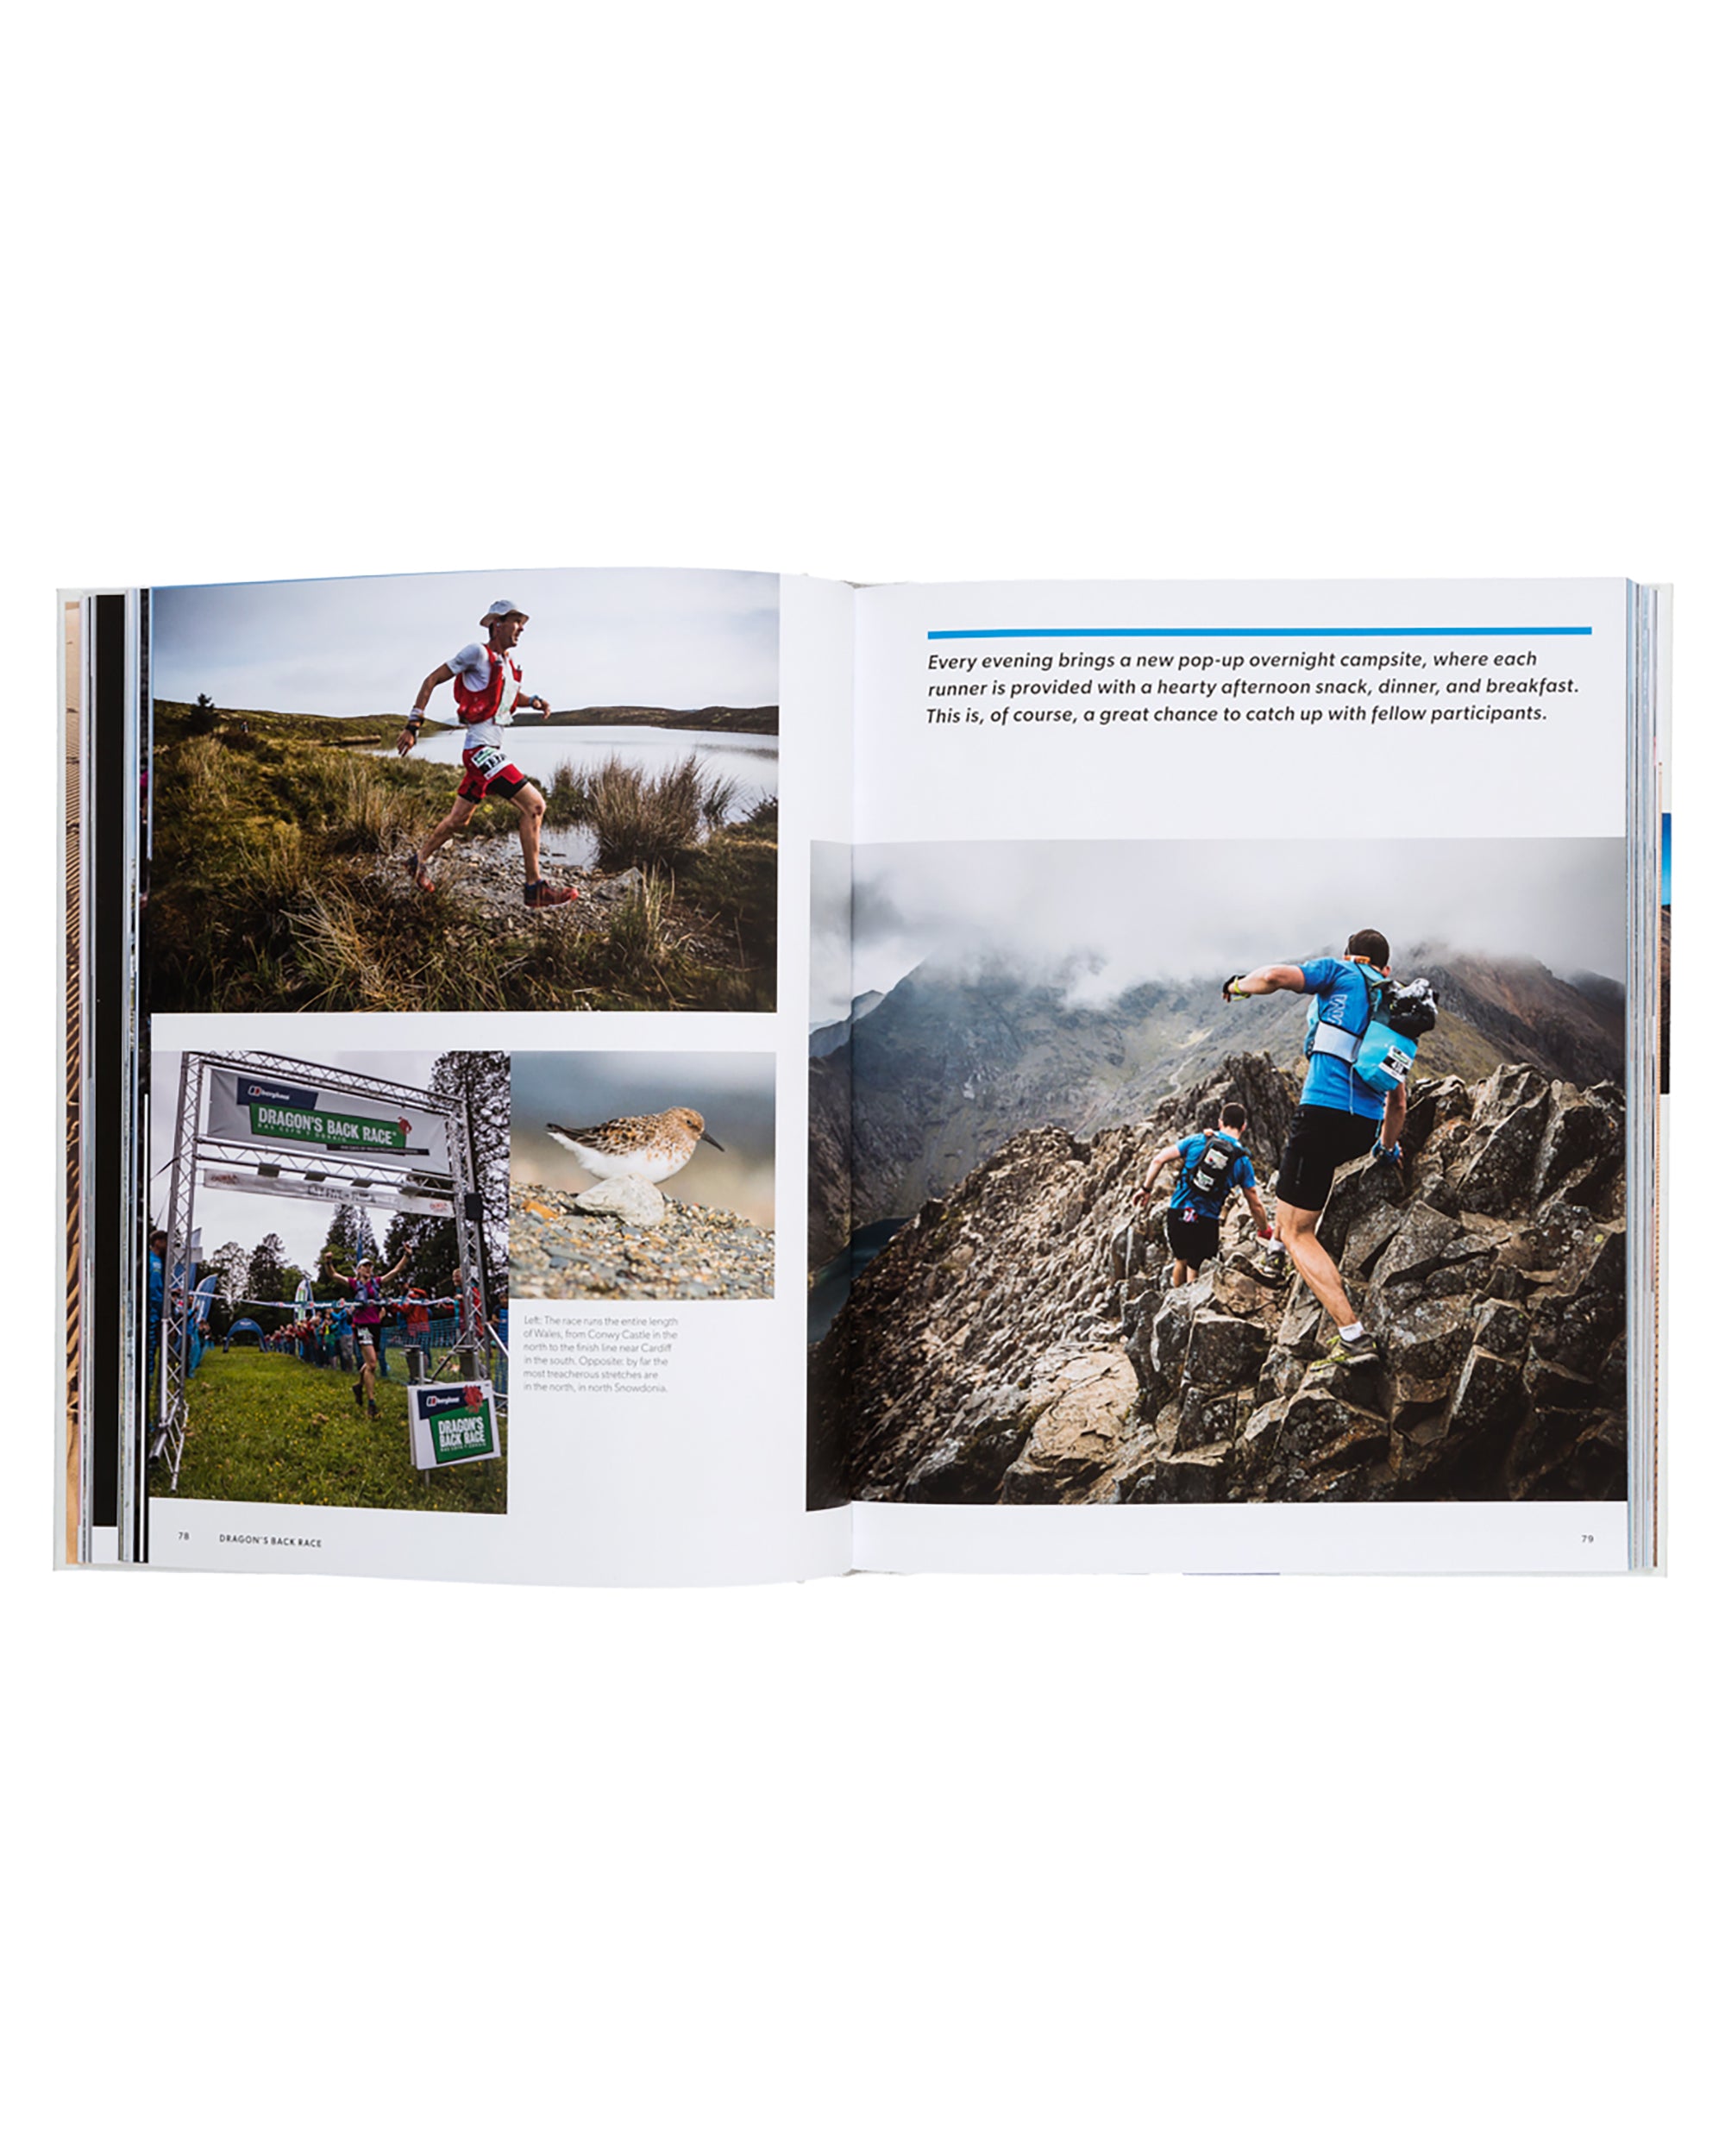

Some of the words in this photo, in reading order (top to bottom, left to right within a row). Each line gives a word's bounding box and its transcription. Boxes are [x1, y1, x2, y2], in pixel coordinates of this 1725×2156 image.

[927, 654, 978, 673] Every
[981, 652, 1054, 672] evening
[1058, 651, 1115, 672] brings
[1120, 655, 1132, 667] a
[1136, 655, 1175, 667] new
[1177, 655, 1245, 672] pop-up
[1249, 651, 1336, 671] overnight
[1339, 650, 1427, 671] campsite,
[1433, 650, 1489, 667] where
[1493, 650, 1537, 667] each
[928, 684, 988, 697] runner
[991, 679, 1006, 696] is
[1009, 679, 1093, 699] provided
[1097, 679, 1136, 695] with
[1140, 682, 1152, 695] a
[1157, 679, 1218, 699] hearty
[1220, 678, 1311, 699] afternoon
[1314, 678, 1372, 697] snack,
[1377, 678, 1440, 696] dinner,
[1446, 678, 1482, 694] and
[1485, 677, 1578, 697] breakfast.
[926, 707, 961, 724] This
[965, 707, 984, 725] is,
[989, 705, 1010, 726] of
[1013, 710, 1077, 724] course,
[1082, 710, 1095, 722] a
[1099, 707, 1150, 726] great
[1153, 705, 1219, 722] chance
[1223, 707, 1242, 722] to
[1245, 705, 1295, 722] catch
[1300, 709, 1323, 725] up
[1327, 705, 1367, 721] with
[1371, 705, 1427, 725] fellow
[1430, 704, 1547, 725] participants.
[259, 1107, 323, 1132] DRAGON'S
[327, 1119, 359, 1140] BACK
[362, 1125, 393, 1145] RACE
[544, 1316, 561, 1326] The
[605, 1316, 619, 1326] the
[621, 1317, 648, 1326] entire
[649, 1317, 678, 1327] length
[524, 1329, 532, 1338] of
[535, 1329, 563, 1339] Wales,
[565, 1330, 586, 1338] from
[587, 1330, 620, 1340] Conwy
[622, 1330, 650, 1339] Castle
[653, 1331, 662, 1339] in
[662, 1331, 678, 1339] the
[524, 1343, 548, 1351] north
[560, 1343, 574, 1351] the
[576, 1343, 599, 1352] finish
[601, 1343, 617, 1352] line
[641, 1344, 672, 1352] Cardiff
[534, 1356, 548, 1364] the
[550, 1356, 575, 1365] south.
[626, 1357, 637, 1367] by
[640, 1357, 650, 1365] far
[547, 1369, 599, 1378] treacherous
[601, 1370, 642, 1379] stretches
[534, 1382, 548, 1391] the
[549, 1383, 575, 1393] north,
[588, 1383, 612, 1392] north
[614, 1384, 668, 1393] Snowdonia.
[438, 1417, 484, 1434] DRAGON'S
[439, 1432, 462, 1447] BACK
[464, 1430, 486, 1445] RACE
[178, 1532, 190, 1540] 78
[219, 1534, 268, 1545] DRAGON'S
[271, 1537, 295, 1546] BACK
[298, 1539, 322, 1547] RACE
